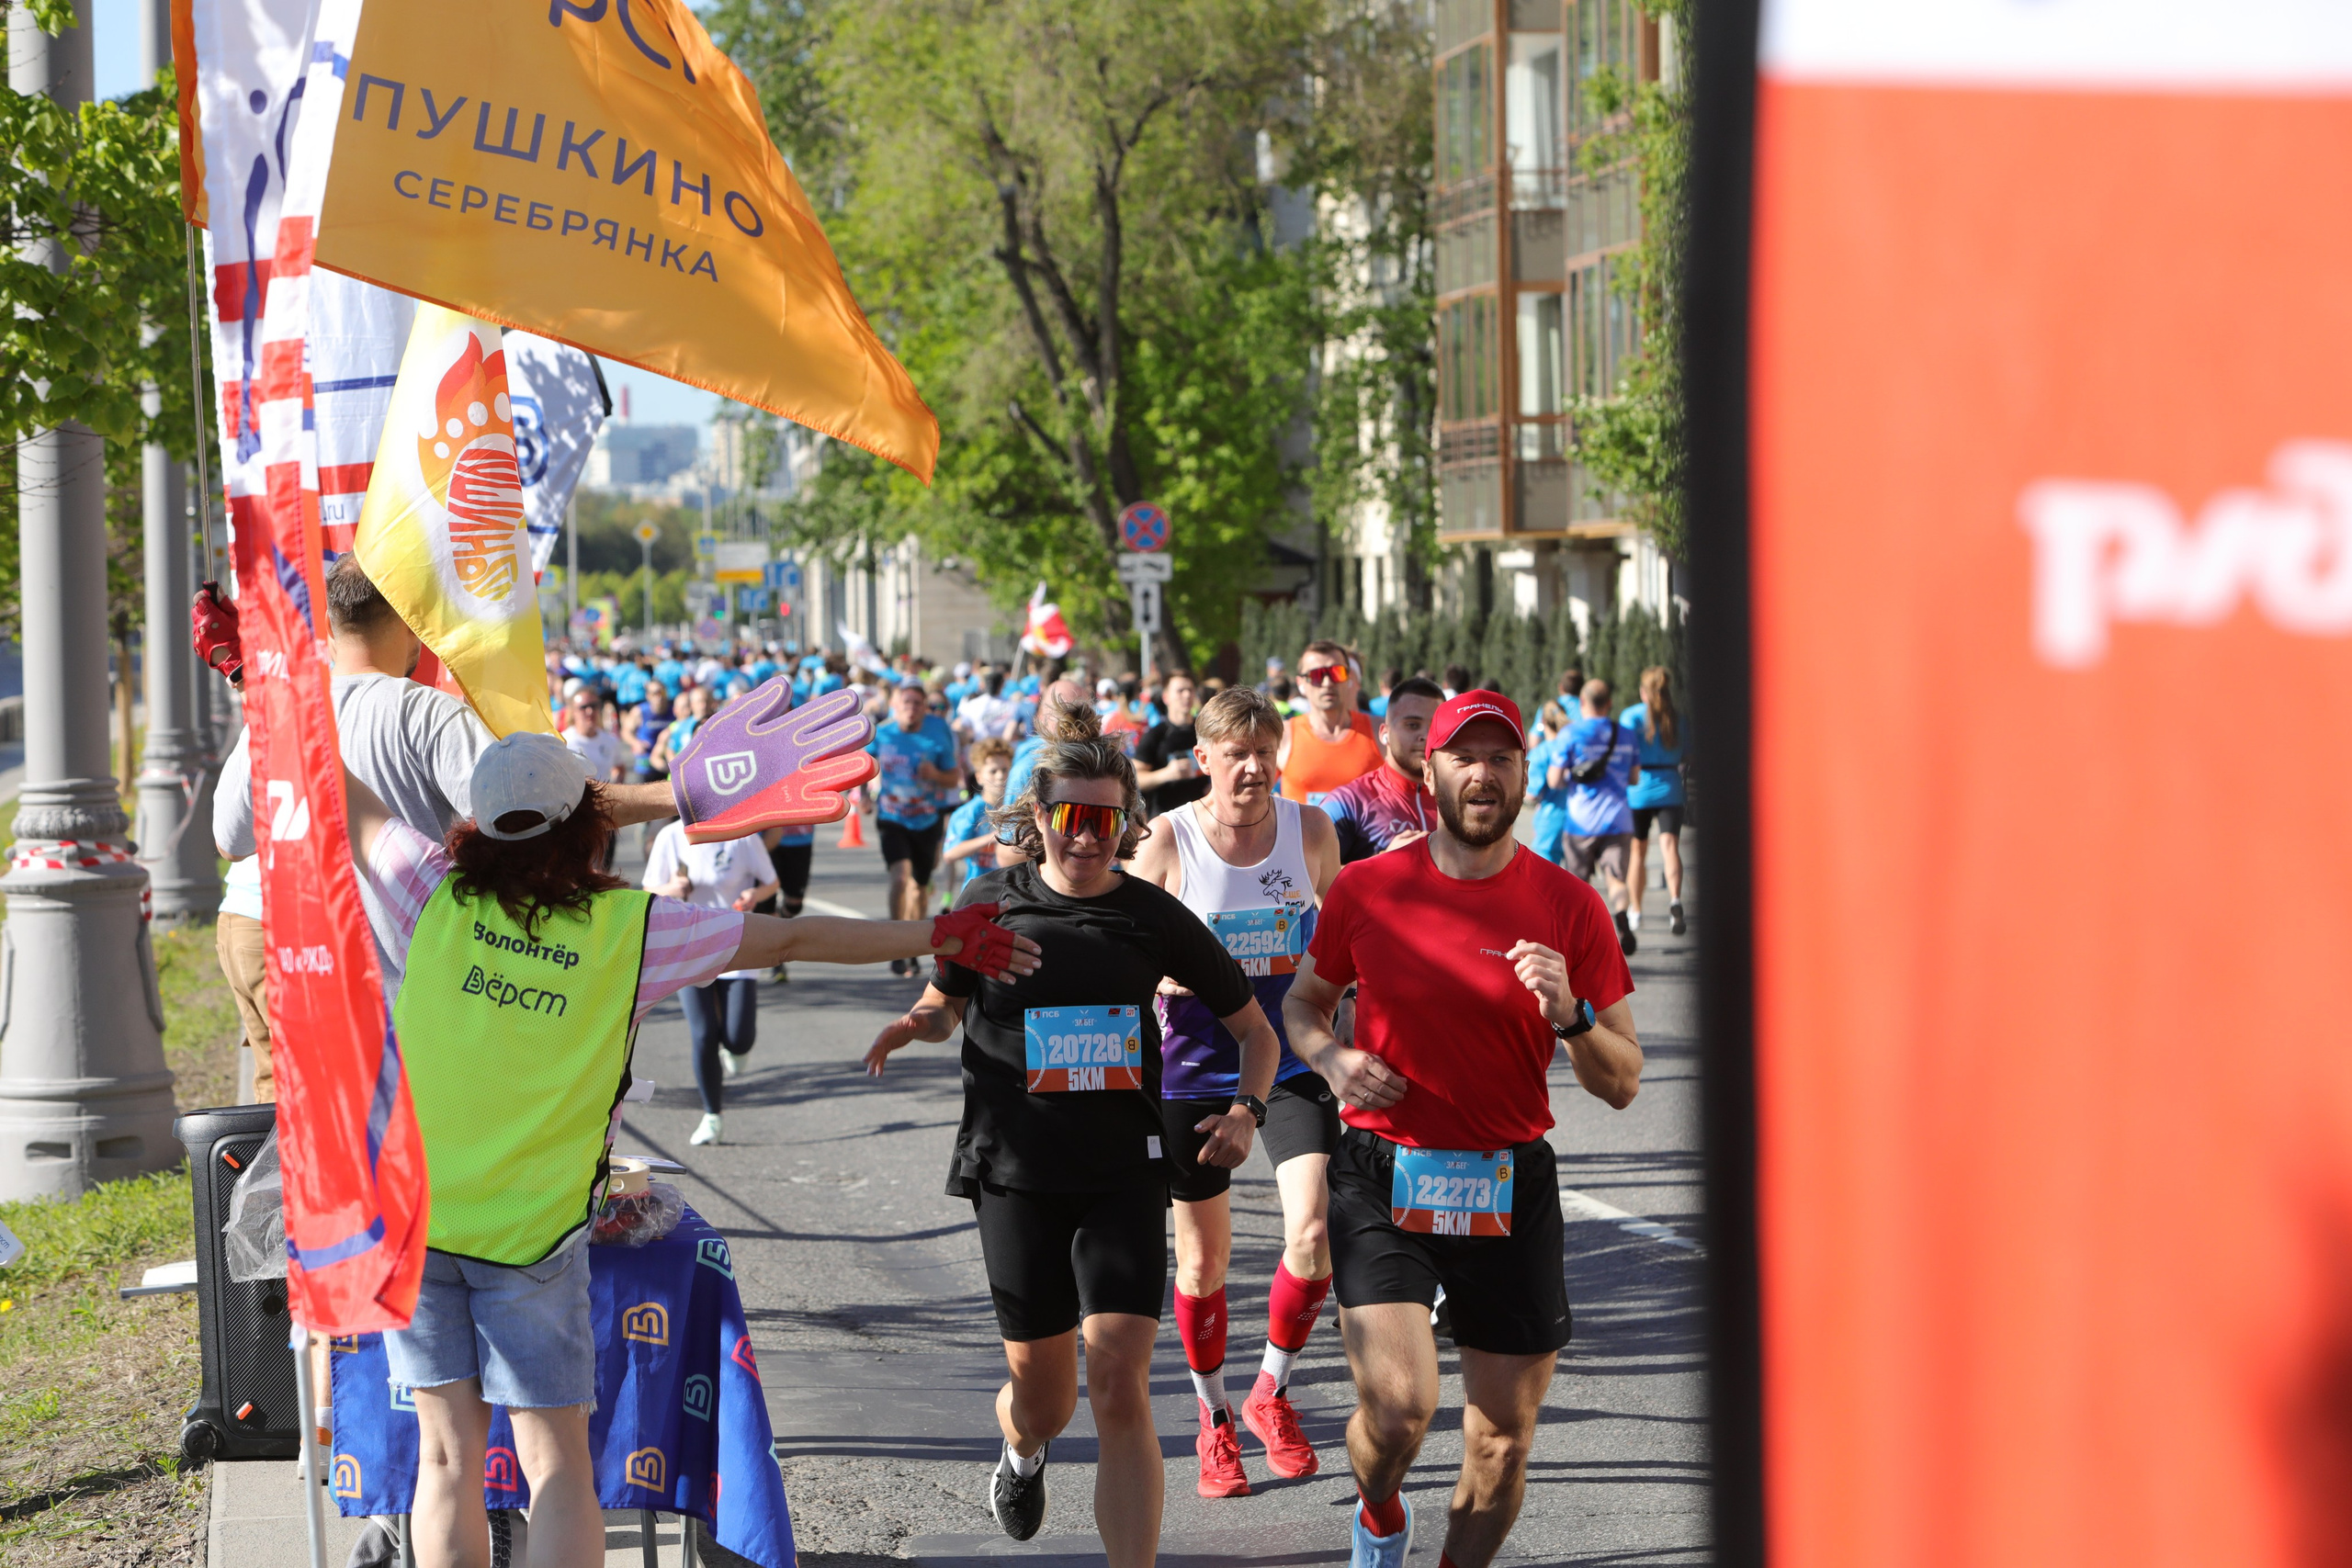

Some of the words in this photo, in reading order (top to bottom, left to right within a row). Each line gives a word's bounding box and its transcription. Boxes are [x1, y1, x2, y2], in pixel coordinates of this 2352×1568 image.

[353, 73, 764, 238] ПУШКИНО
[393, 170, 719, 283] СЕРЕБРЯНКА
[473, 919, 580, 970] Волонтёр
[1226, 930, 1285, 956] 22592
[1047, 1032, 1123, 1065] 20726
[1415, 1174, 1491, 1209] 22273
